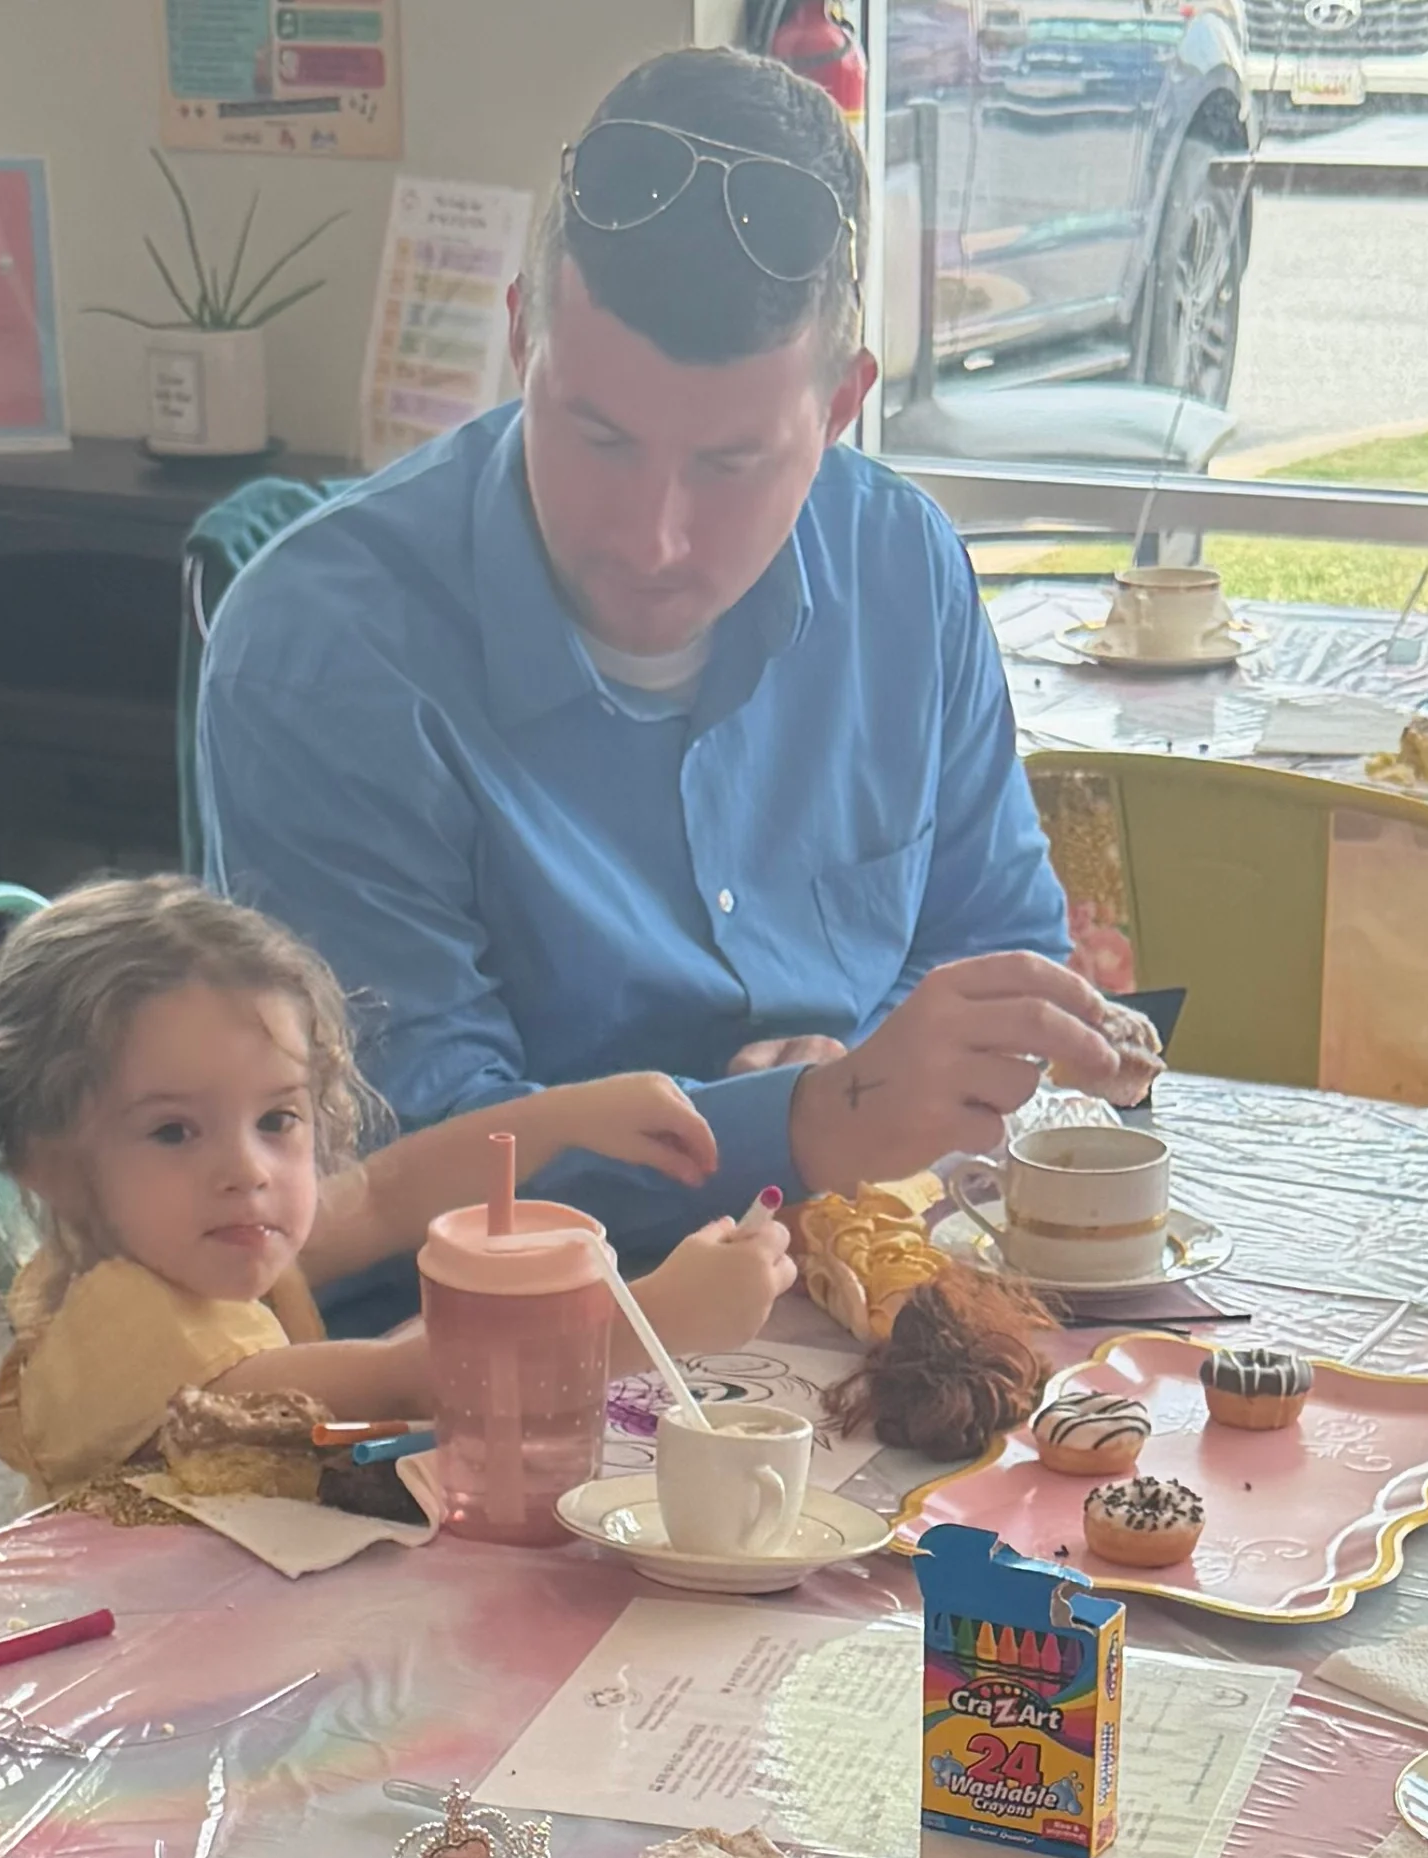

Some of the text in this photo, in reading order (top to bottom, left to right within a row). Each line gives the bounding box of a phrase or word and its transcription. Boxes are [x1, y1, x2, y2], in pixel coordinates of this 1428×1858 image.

[966, 1733, 1043, 1786] 24
[950, 1773, 1059, 1808] Washable
[973, 1796, 1034, 1818] Crayons
